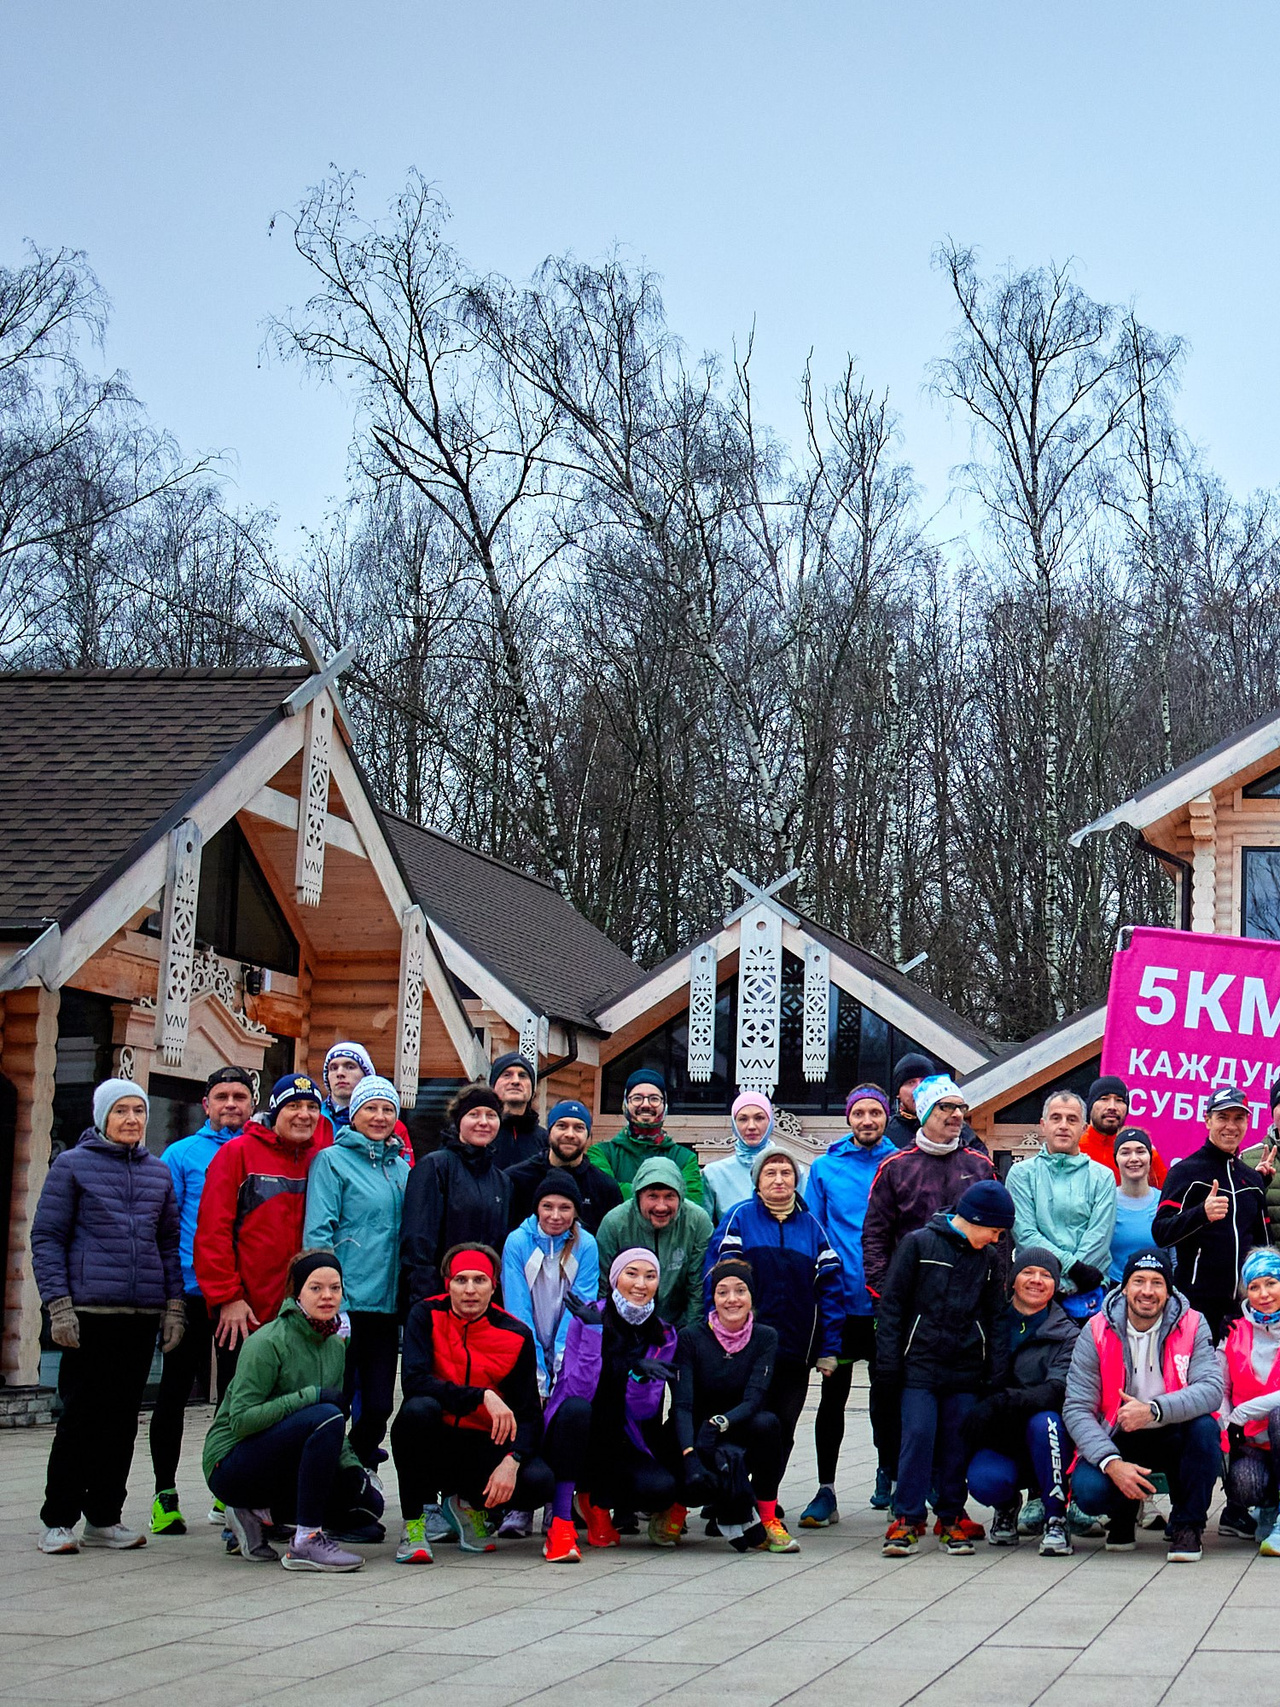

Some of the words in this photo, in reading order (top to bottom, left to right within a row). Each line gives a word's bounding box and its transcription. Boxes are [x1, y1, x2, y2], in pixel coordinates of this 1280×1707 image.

[1128, 1088, 1268, 1130] СУБТ
[1174, 1354, 1190, 1372] Sa
[1047, 1416, 1062, 1484] DEMIX
